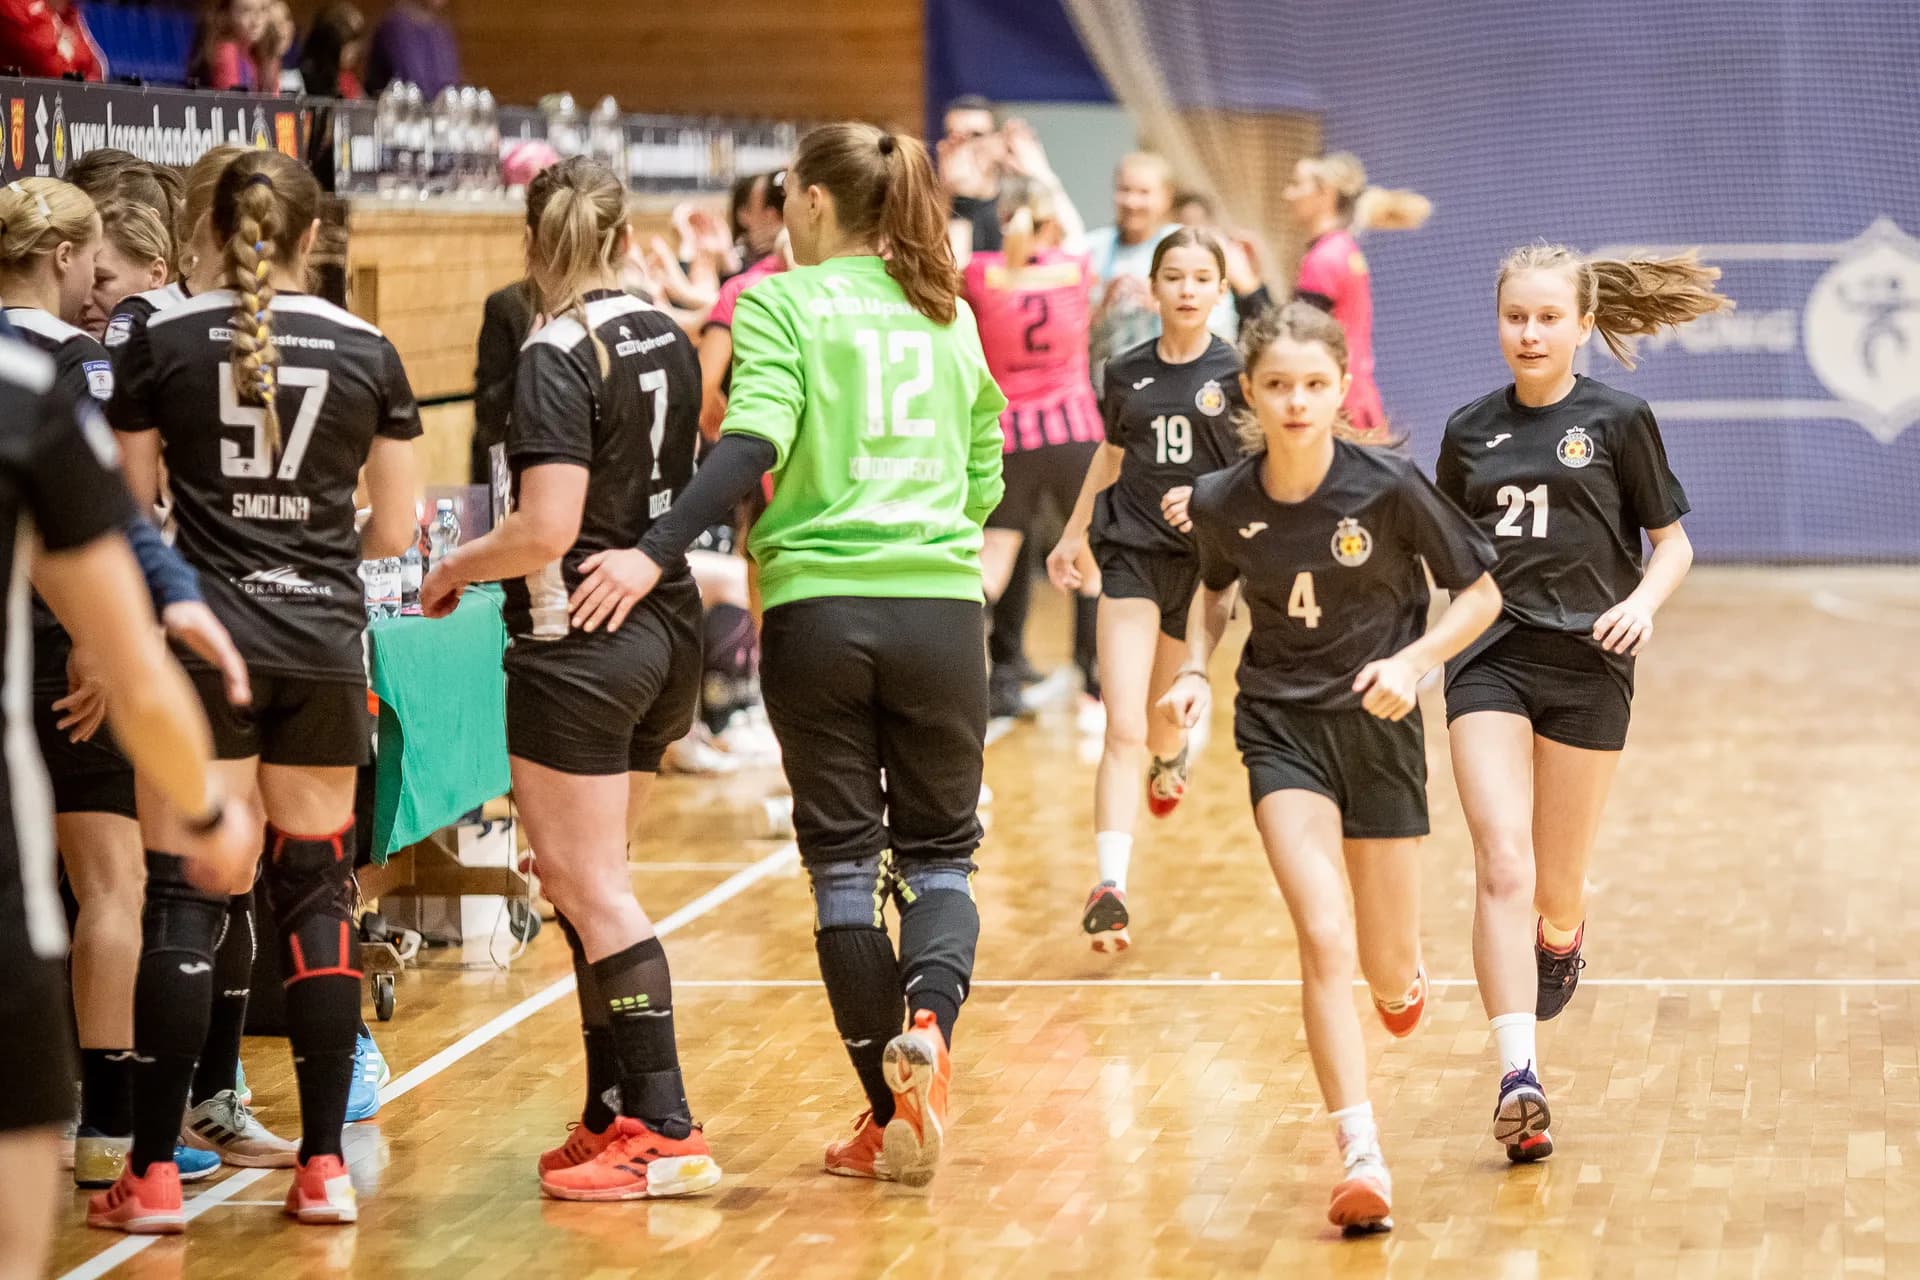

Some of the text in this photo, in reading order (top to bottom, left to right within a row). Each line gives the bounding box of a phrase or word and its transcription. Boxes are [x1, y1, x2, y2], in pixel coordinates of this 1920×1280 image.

[1023, 294, 1050, 353] 2
[855, 328, 936, 437] 12
[218, 362, 330, 481] 57
[638, 368, 669, 480] 7
[1150, 414, 1193, 464] 19
[1495, 484, 1548, 538] 21
[1287, 571, 1322, 629] 4
